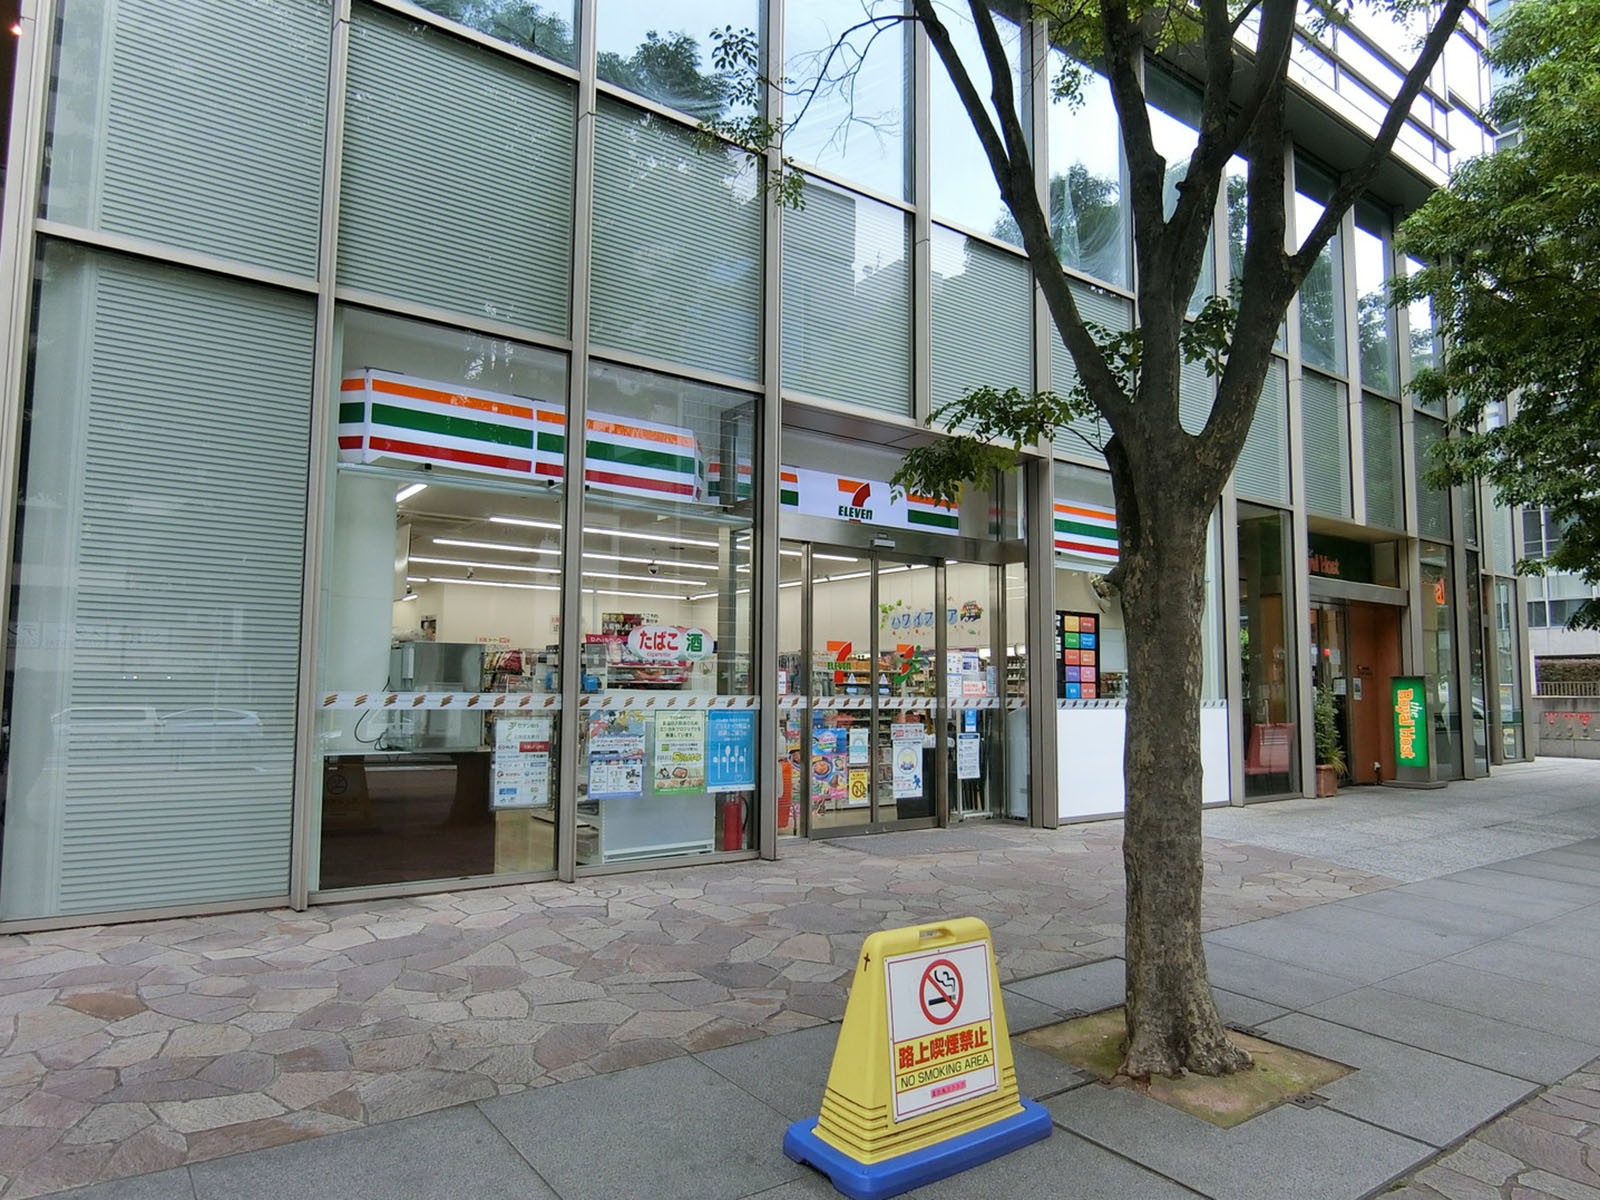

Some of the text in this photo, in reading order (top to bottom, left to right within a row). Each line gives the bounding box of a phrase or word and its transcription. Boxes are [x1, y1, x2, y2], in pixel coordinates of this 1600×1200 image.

[640, 630, 703, 653] たばこ 酒
[1395, 688, 1416, 759] Royal Host
[899, 1026, 989, 1070] 路上喫煙禁止
[901, 1074, 916, 1089] NO
[917, 1060, 962, 1084] SMOKING
[964, 1053, 990, 1070] AREA
